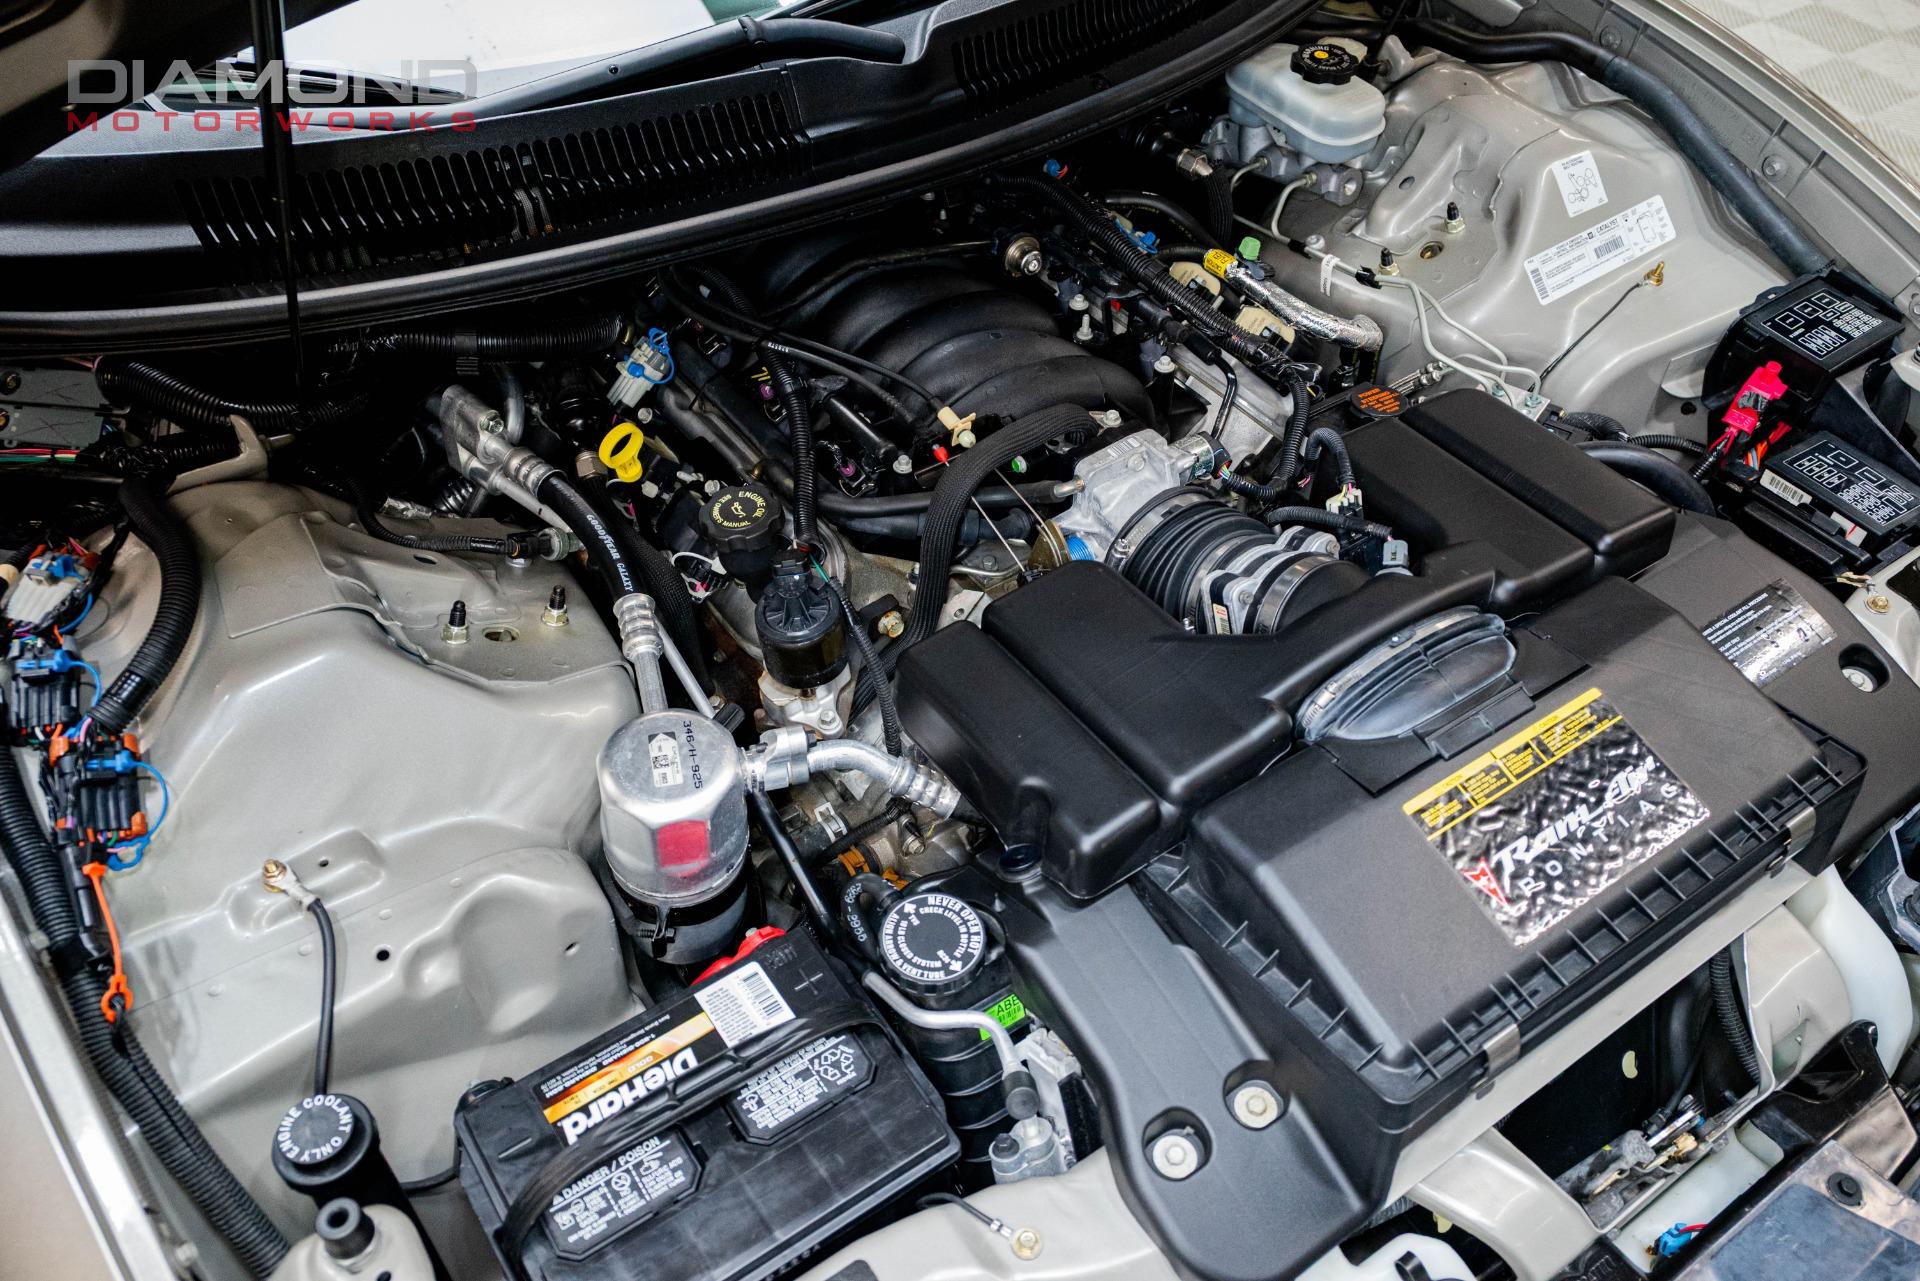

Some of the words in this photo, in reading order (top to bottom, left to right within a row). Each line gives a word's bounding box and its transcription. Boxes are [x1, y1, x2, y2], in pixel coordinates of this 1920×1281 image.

[1595, 217, 1618, 233] CATALYST
[718, 494, 731, 503] SEE
[738, 490, 765, 507] ENGINE
[752, 508, 764, 517] OIL
[586, 514, 620, 559] GOODYEAR
[683, 720, 702, 788] 346/H-925
[1487, 801, 1607, 895] Ram
[1517, 780, 1681, 896] PONTIAC
[928, 896, 961, 911] NEVER
[885, 912, 899, 934] ALIGN
[943, 910, 962, 925] LEVEL
[953, 934, 968, 958] BOTTLE
[960, 909, 979, 932] OPEN
[885, 935, 900, 960] ARROW
[897, 935, 913, 958] CLOSED
[911, 956, 942, 967] SYSTEM
[967, 935, 980, 955] HOT
[902, 962, 923, 976] VENT
[923, 970, 945, 978] TUBE
[996, 994, 1019, 1016] ABE
[601, 1032, 655, 1066] 1-800-DIEHARD
[626, 1054, 654, 1073] GOLD
[544, 1065, 597, 1098] DIEHARD.COM
[556, 1046, 698, 1145] DieHard
[302, 1094, 352, 1132] COOLANT
[277, 1106, 301, 1158] ENGINE
[300, 1136, 342, 1161] ONLY
[561, 1164, 610, 1199] DANGER
[617, 1135, 661, 1166] POISON
